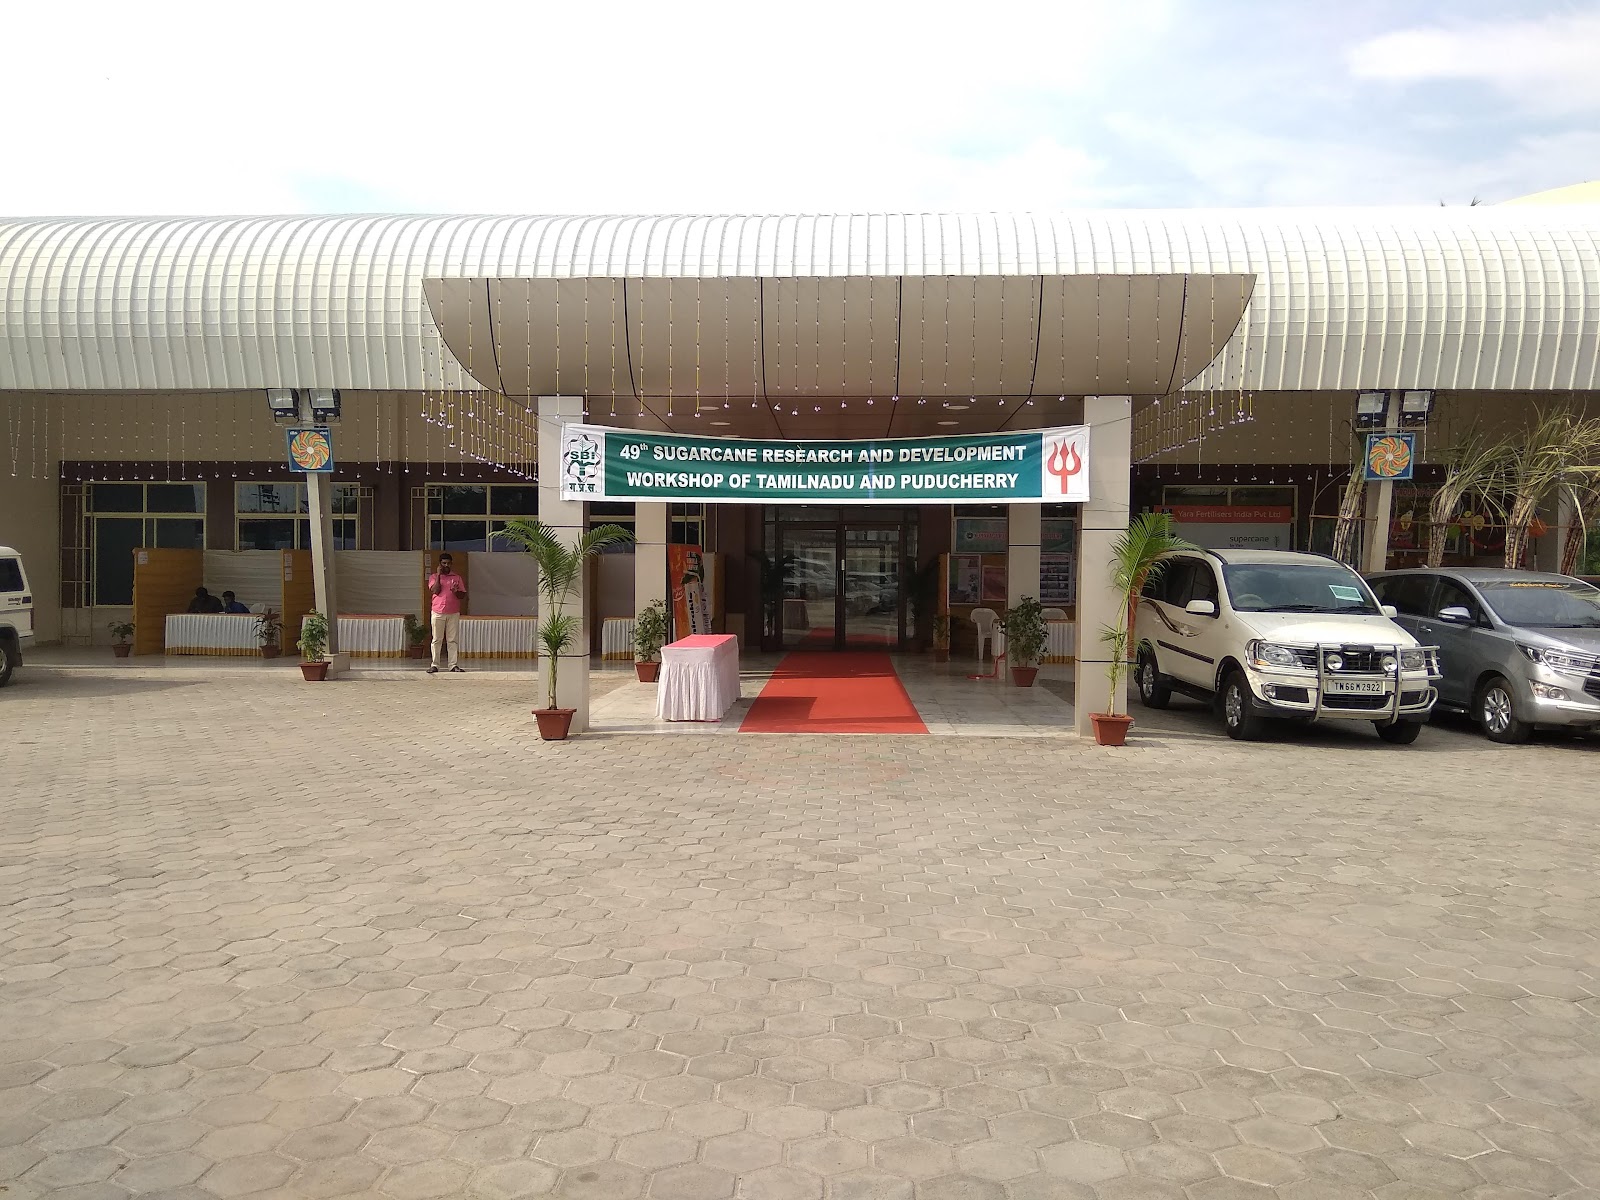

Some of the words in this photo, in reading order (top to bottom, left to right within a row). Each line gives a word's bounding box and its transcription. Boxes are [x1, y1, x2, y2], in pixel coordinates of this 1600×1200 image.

[619, 443, 649, 460] 49th
[653, 446, 757, 463] SUGARCANE
[762, 448, 852, 463] RESEARCH
[857, 448, 894, 463] AND
[898, 445, 1027, 462] DEVELOPMENT
[627, 471, 724, 487] WORKSHOP
[728, 473, 751, 488] OF
[755, 474, 855, 489] TAMILNADU
[859, 474, 895, 489] AND
[900, 473, 1019, 489] PUDUCHERRY
[1178, 510, 1194, 518] Yara
[1196, 510, 1232, 518] Fertilisers
[1234, 510, 1252, 518] India
[1254, 510, 1267, 518] Pvt
[1269, 510, 1281, 518] Ltd
[1229, 535, 1270, 543] supercane
